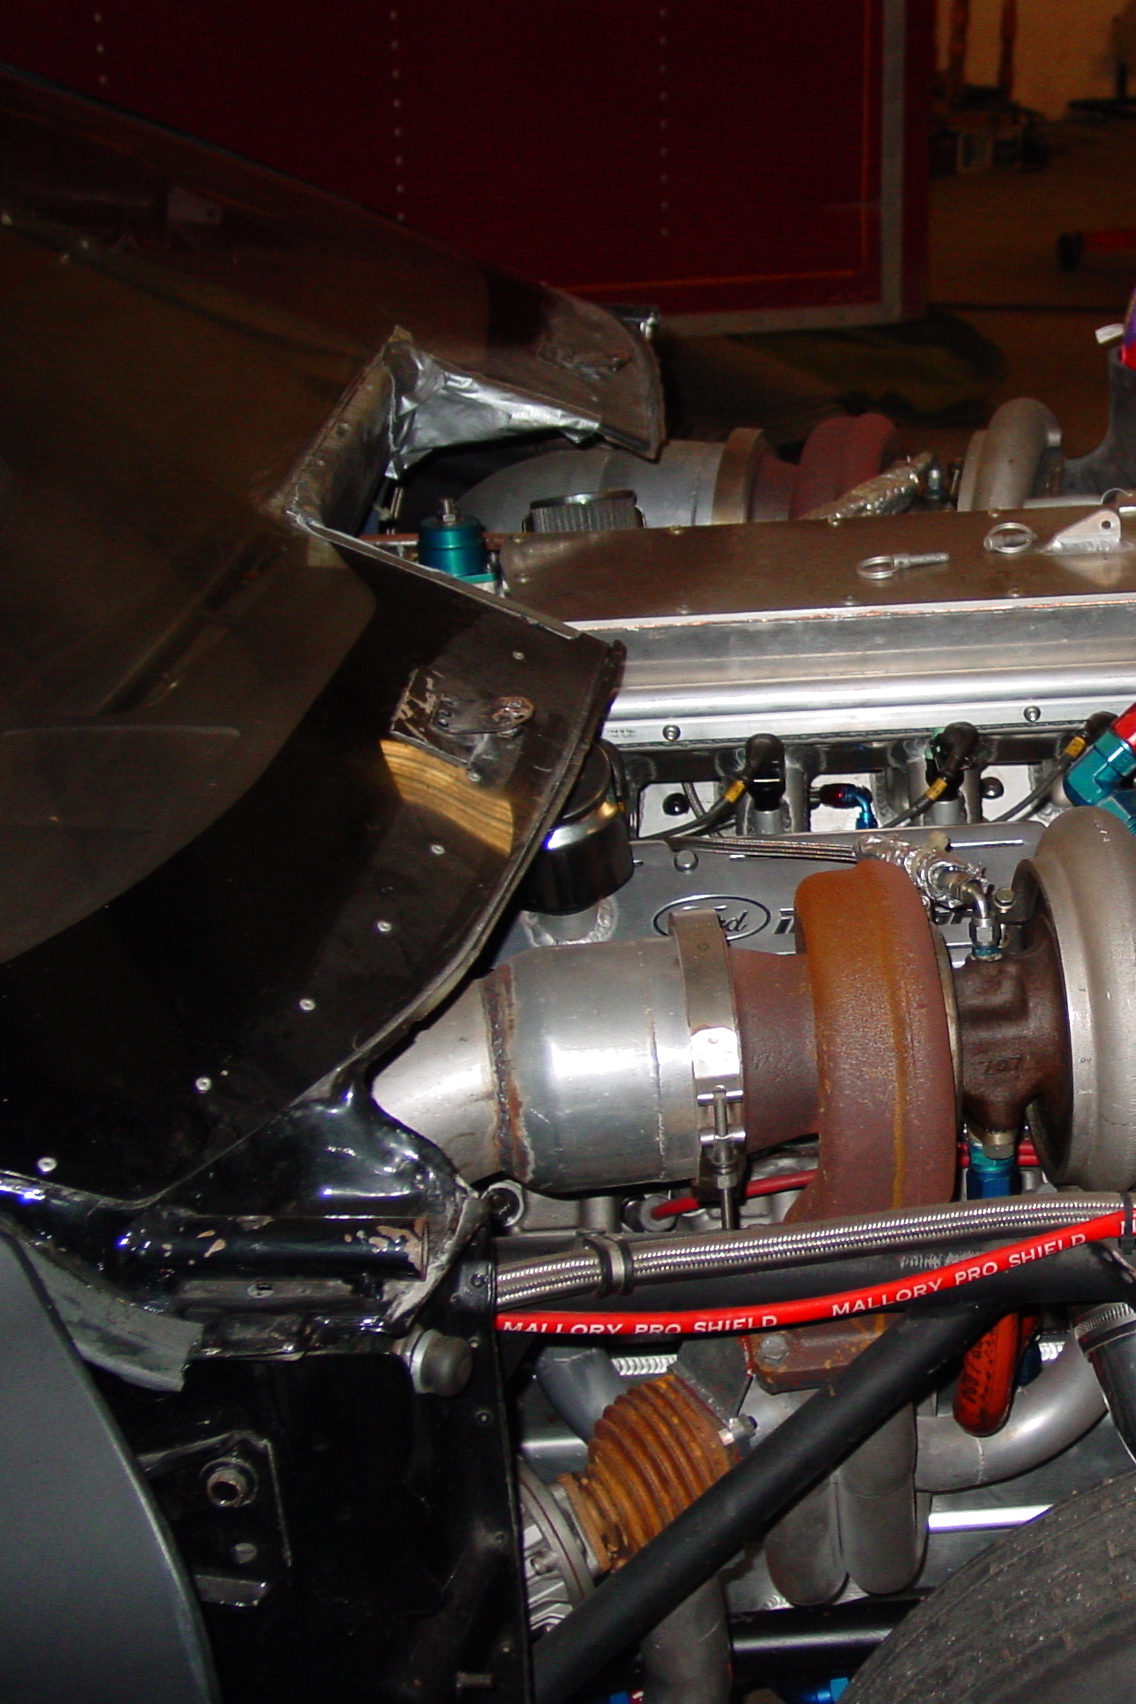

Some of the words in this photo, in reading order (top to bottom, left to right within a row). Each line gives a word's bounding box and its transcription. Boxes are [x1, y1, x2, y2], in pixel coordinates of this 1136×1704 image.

[831, 1279, 943, 1317] MALLORY
[954, 1262, 999, 1286] PRO
[1009, 1233, 1087, 1268] SHIELD
[503, 1321, 624, 1335] MALLORY
[634, 1323, 681, 1335] PRO
[693, 1315, 778, 1334] SHIELD
